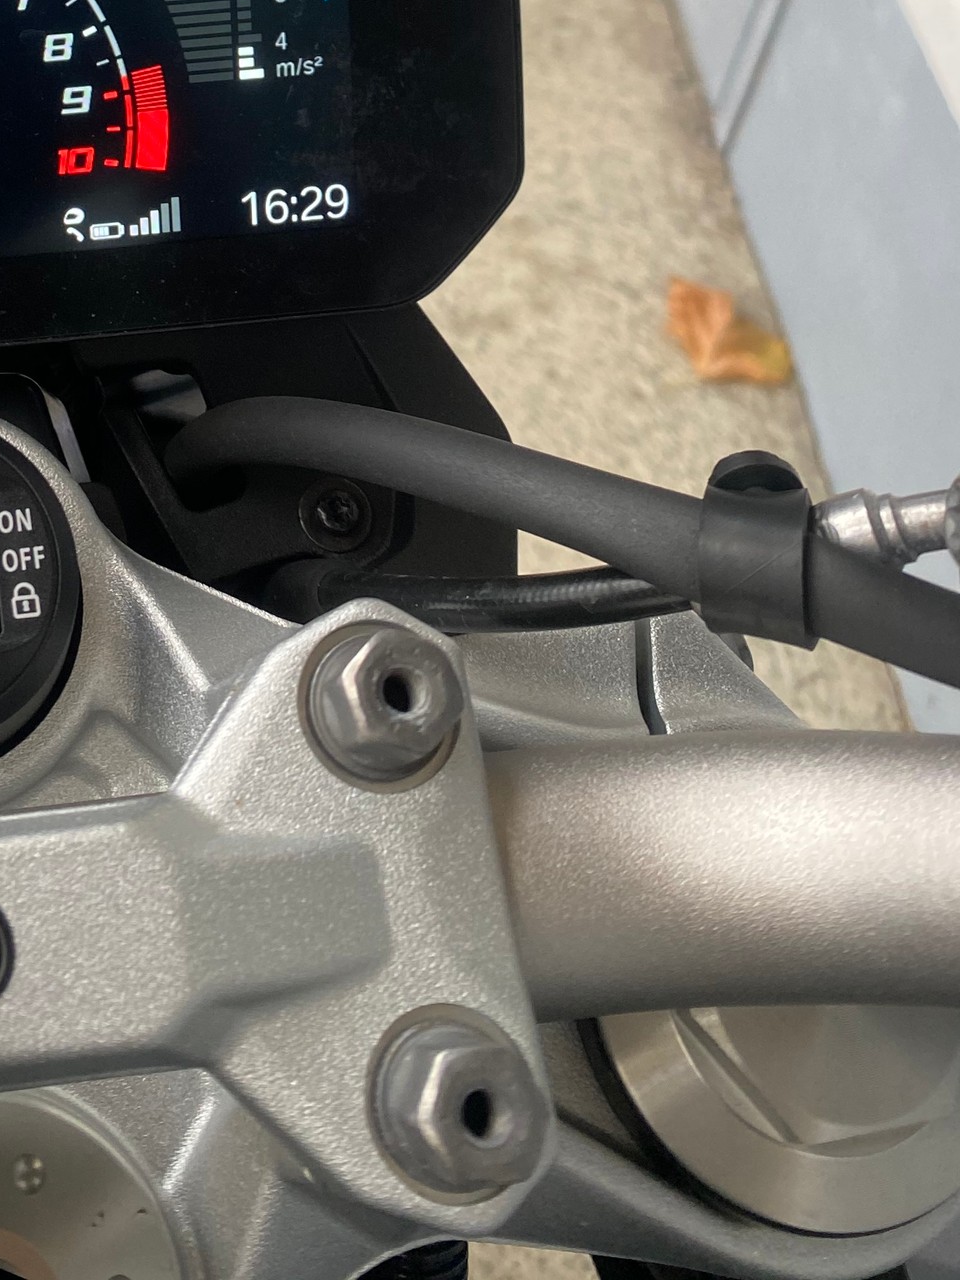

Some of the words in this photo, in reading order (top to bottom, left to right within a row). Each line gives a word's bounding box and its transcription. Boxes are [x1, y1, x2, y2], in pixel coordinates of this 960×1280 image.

[42, 32, 74, 63] 8
[275, 31, 288, 50] 4
[60, 85, 93, 115] 9
[57, 146, 95, 176] 10
[241, 183, 350, 226] 16:29
[1, 545, 45, 573] OFF
